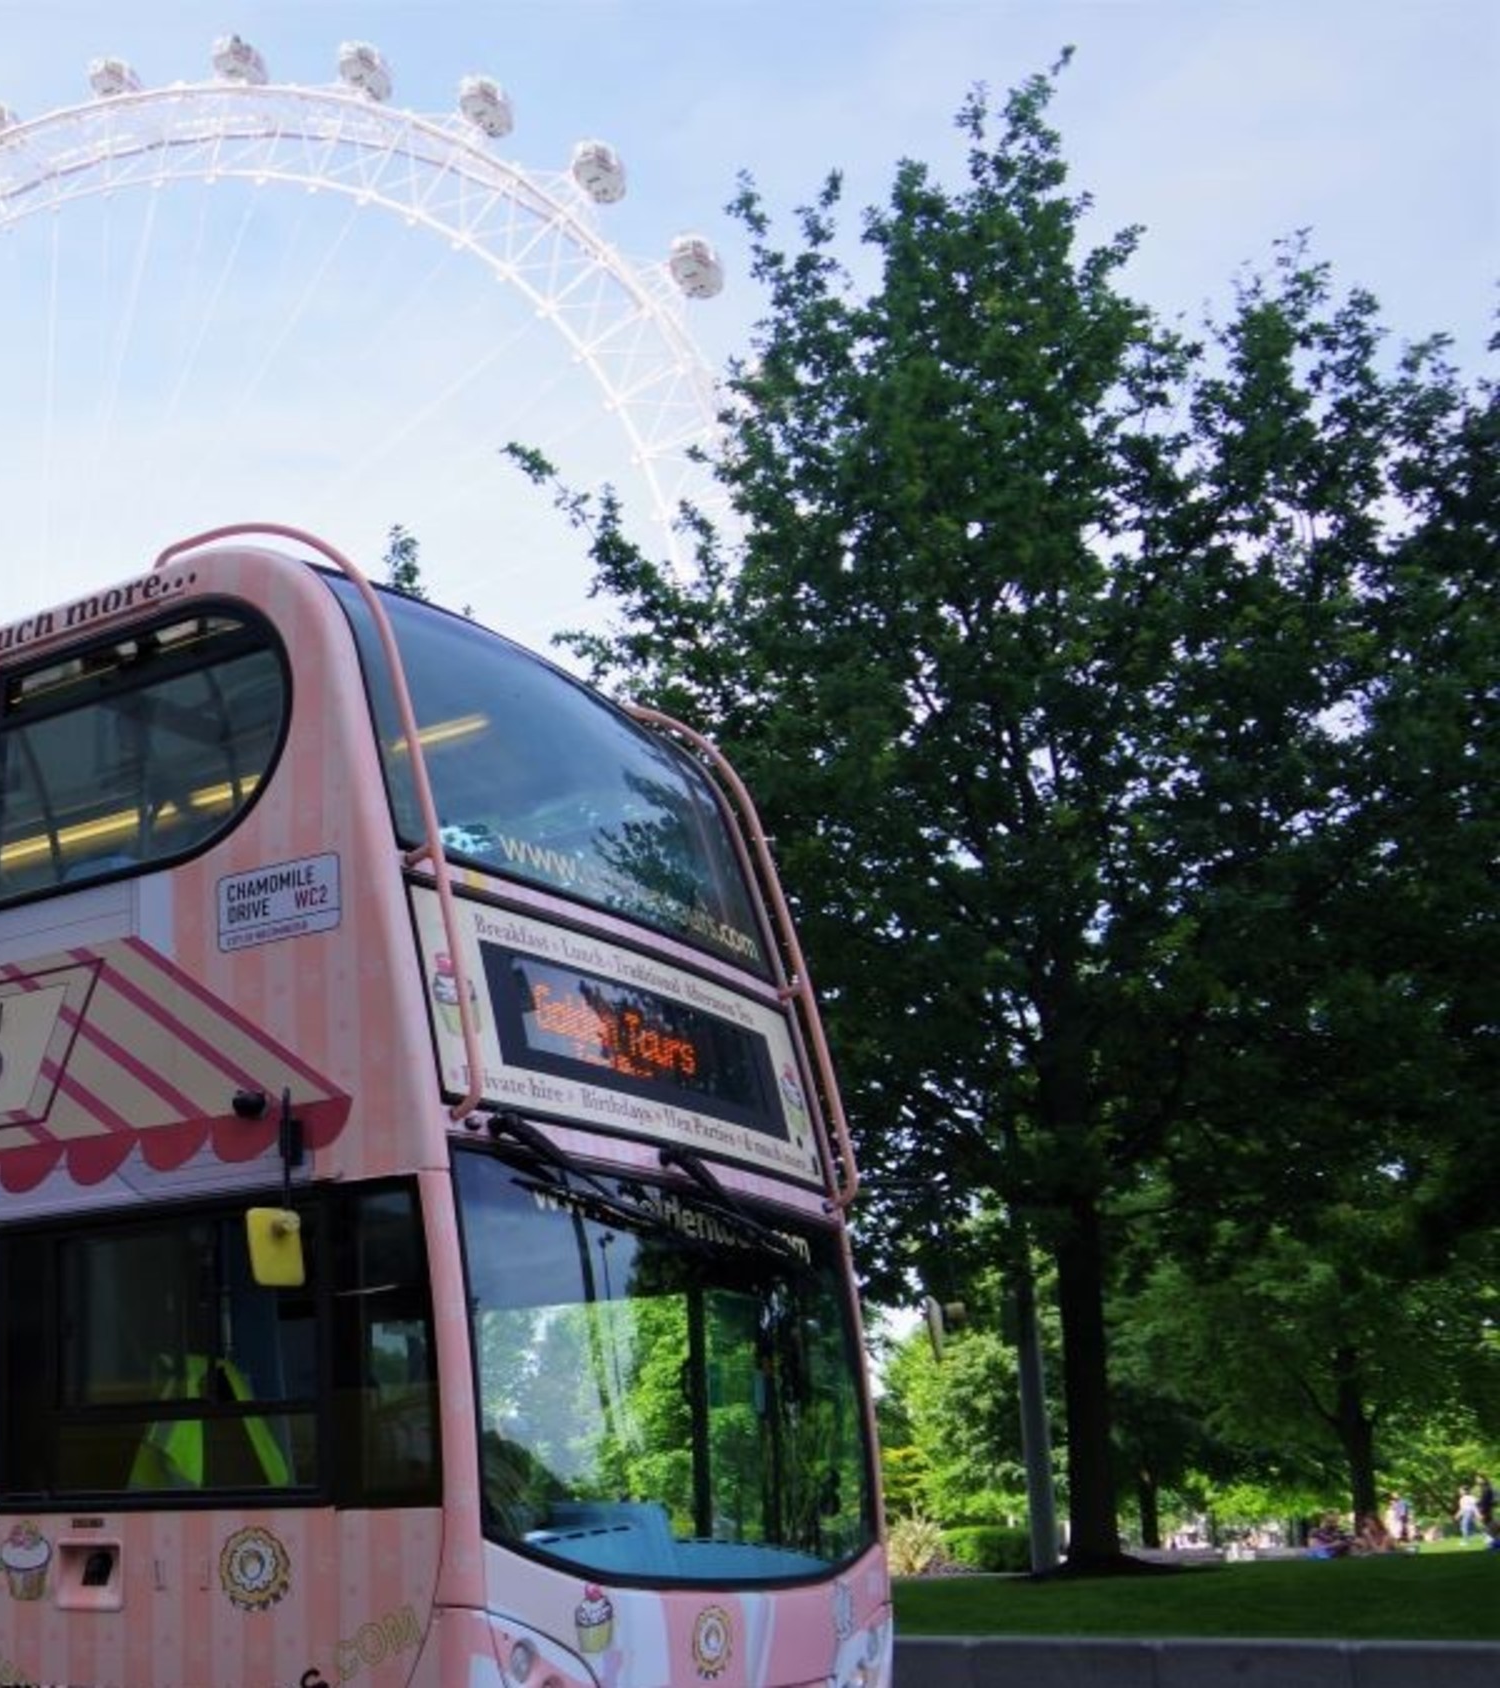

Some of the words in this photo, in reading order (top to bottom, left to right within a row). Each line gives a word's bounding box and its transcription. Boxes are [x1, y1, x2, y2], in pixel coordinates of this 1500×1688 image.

[227, 865, 316, 902] CHAMOMILE
[227, 897, 270, 923] DRIVE
[295, 884, 328, 909] WC2
[473, 912, 550, 951] Breakfast
[561, 937, 605, 967] Lunch
[622, 1010, 697, 1075] Tours
[528, 1076, 564, 1101] hire
[579, 1086, 652, 1125] Birthdays
